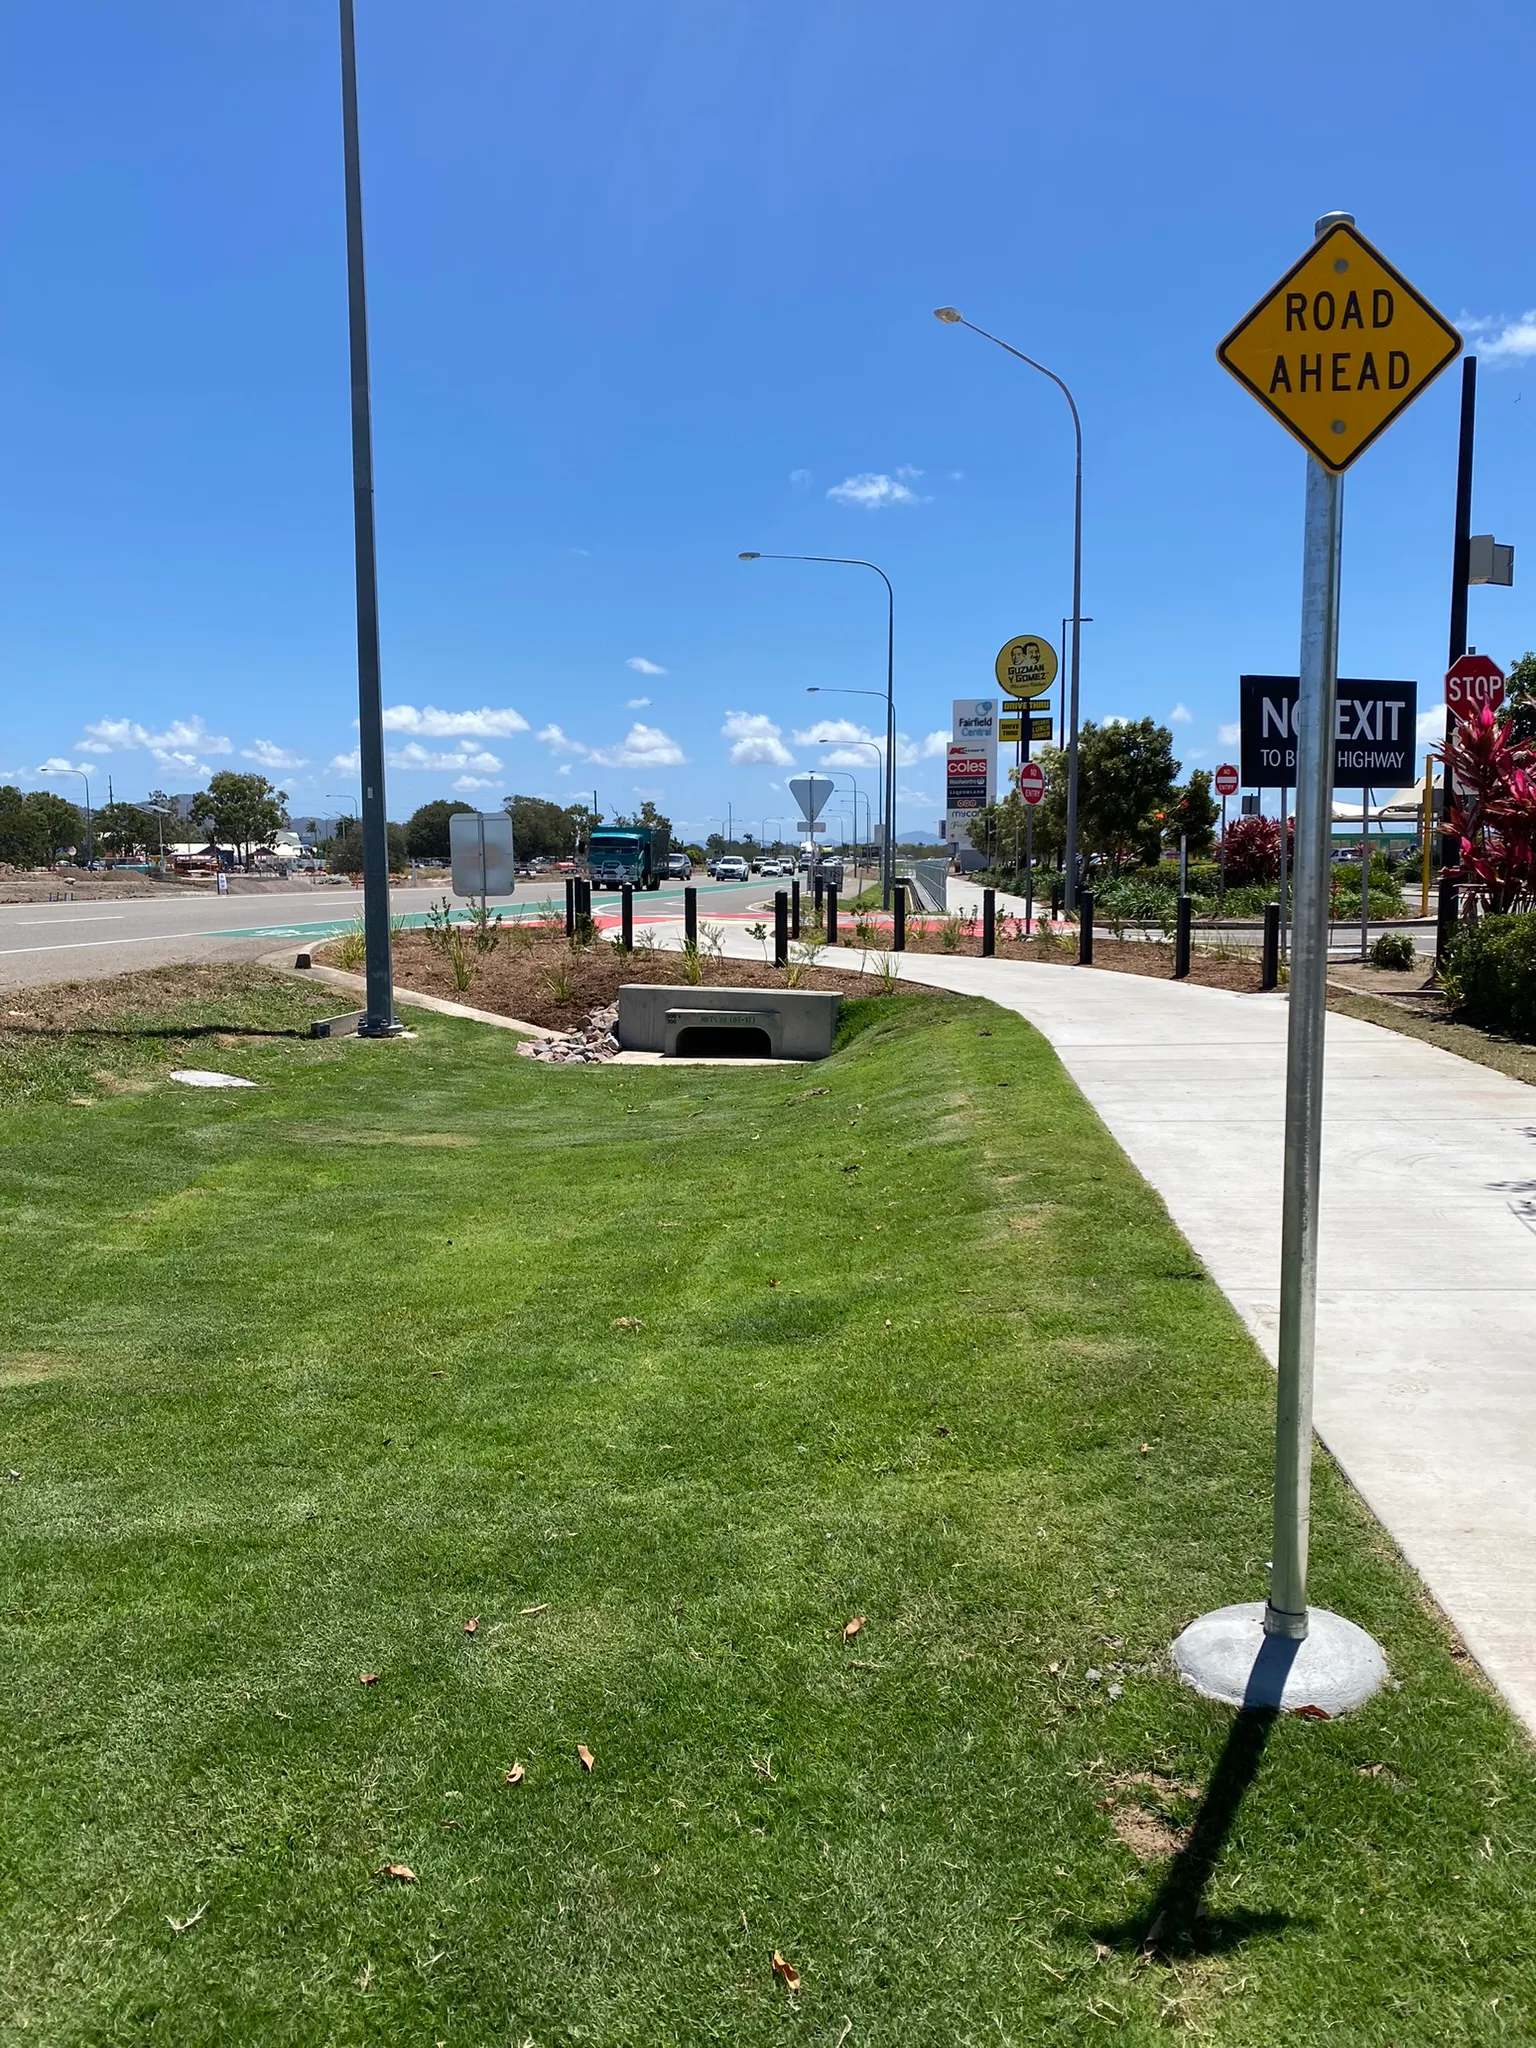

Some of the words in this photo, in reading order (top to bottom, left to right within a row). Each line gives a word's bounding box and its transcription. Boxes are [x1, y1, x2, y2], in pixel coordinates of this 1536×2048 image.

[1286, 289, 1394, 332] ROAD
[1269, 350, 1410, 394] AHEAD
[1007, 664, 1045, 675] GUZMAN
[1008, 675, 1014, 683] Y
[1017, 672, 1046, 682] GOMEZ
[1449, 675, 1502, 702] STOP
[1004, 702, 1027, 710] DRIVE
[1029, 701, 1049, 709] THRU
[958, 717, 993, 727] Fairfield
[1335, 699, 1405, 741] EXIT
[961, 727, 992, 737] Central
[1260, 749, 1281, 767] TO
[1337, 751, 1405, 769] HIGHWAY
[948, 760, 987, 773] coles
[1030, 768, 1038, 777] NO
[1025, 789, 1041, 798] ENTRY
